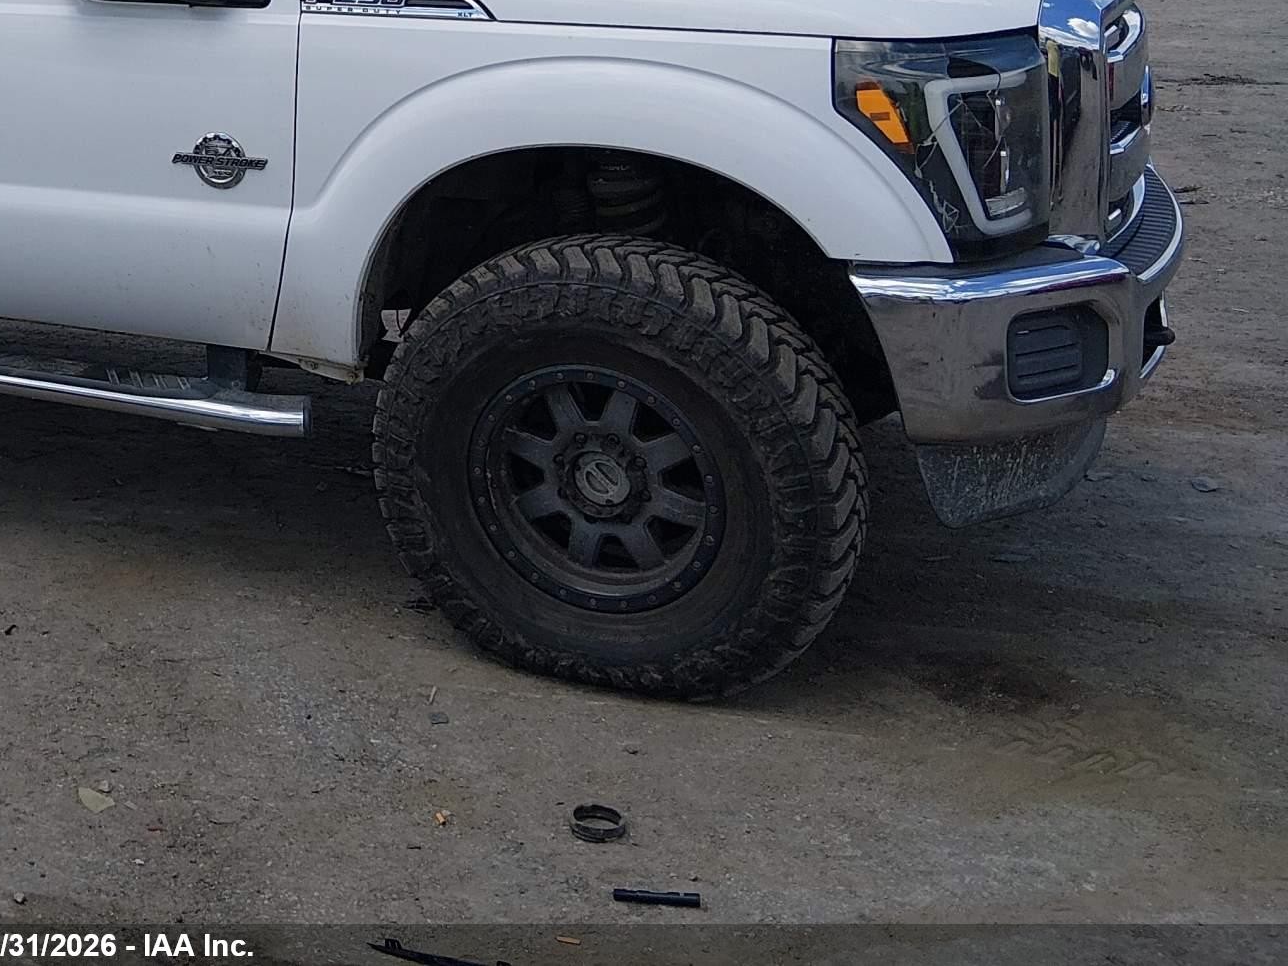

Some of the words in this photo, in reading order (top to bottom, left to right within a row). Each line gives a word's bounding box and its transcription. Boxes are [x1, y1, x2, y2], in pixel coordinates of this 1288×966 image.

[305, 5, 354, 13] SUPER
[362, 7, 402, 15] DUTY
[456, 11, 474, 19] XLT
[172, 152, 215, 166] POWER
[214, 156, 268, 170] STROKE
